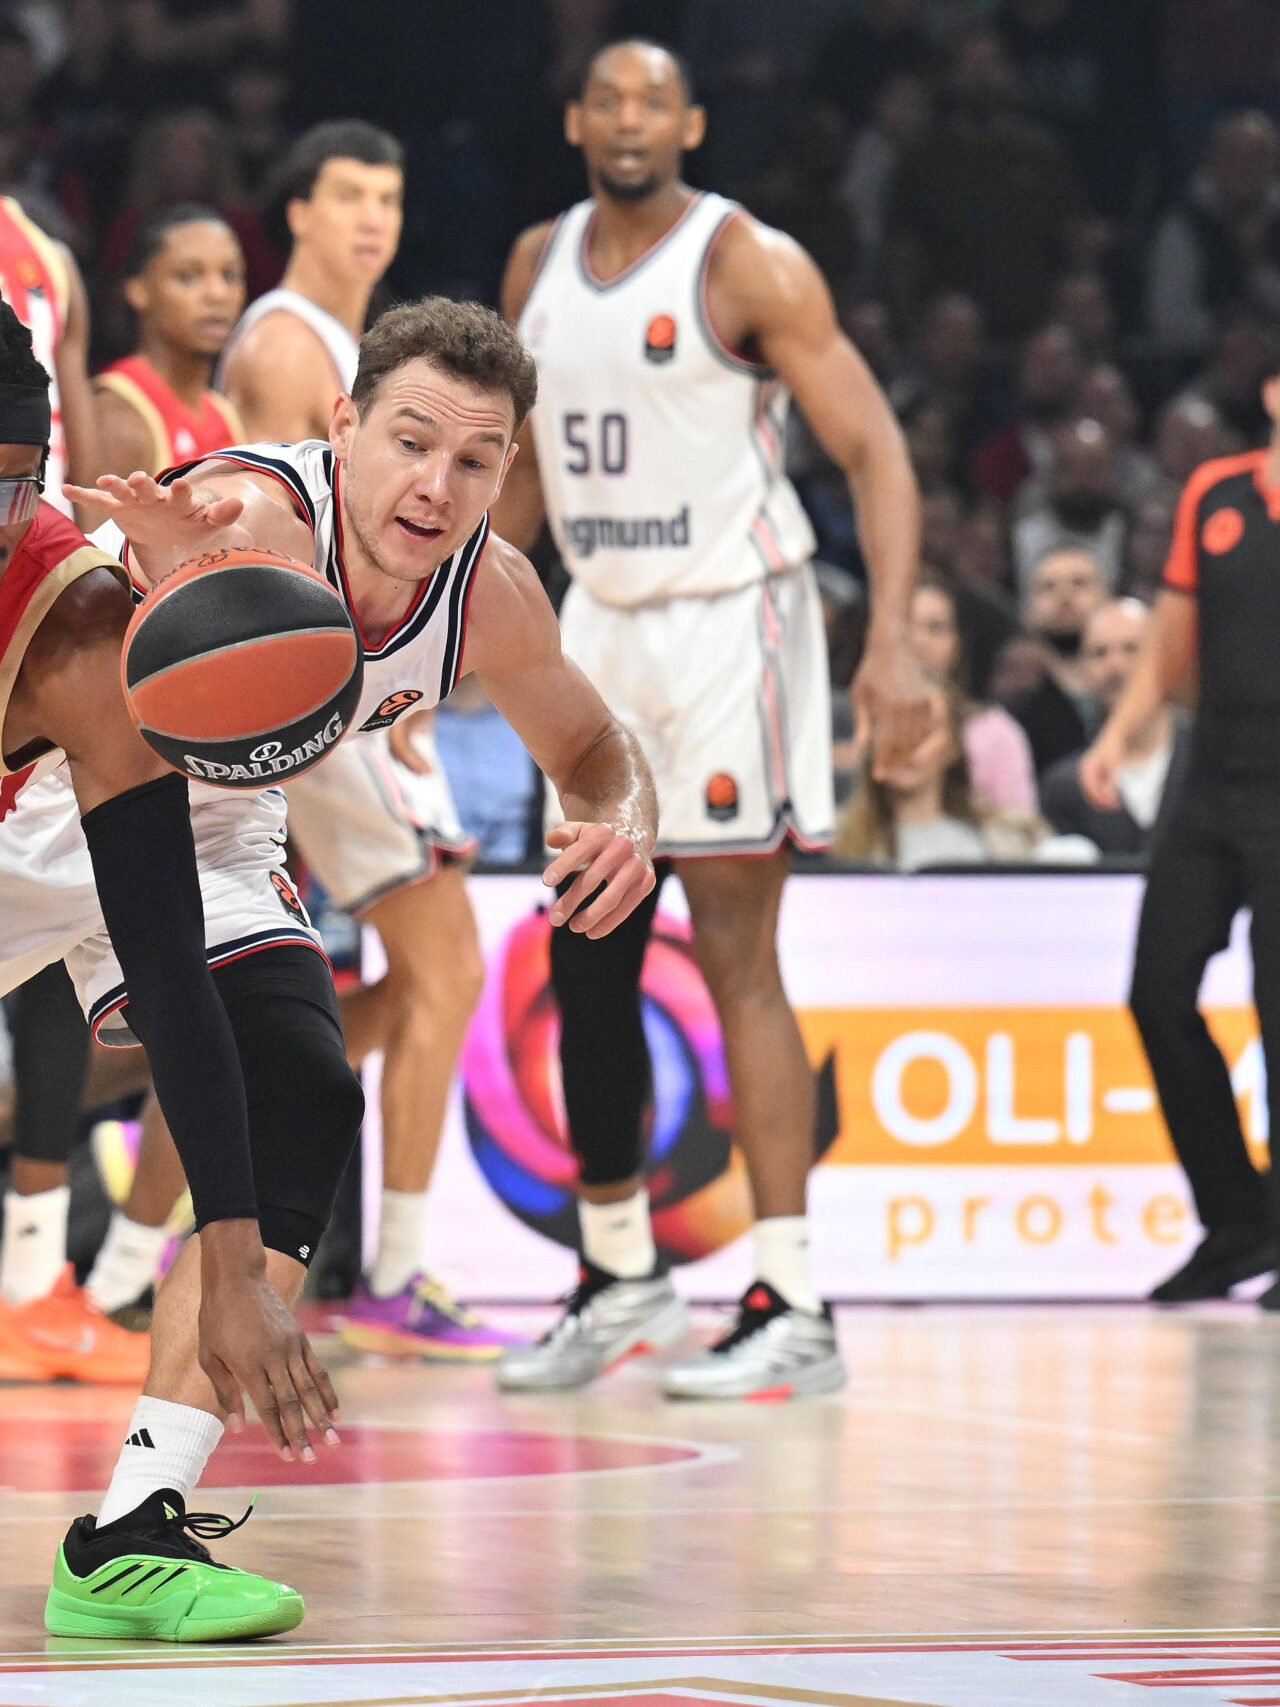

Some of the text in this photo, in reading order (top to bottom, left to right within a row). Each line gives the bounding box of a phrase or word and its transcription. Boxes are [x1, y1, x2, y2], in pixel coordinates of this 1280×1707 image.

[564, 412, 628, 476] 50
[563, 503, 690, 558] gmund
[183, 711, 347, 781] SPALDING
